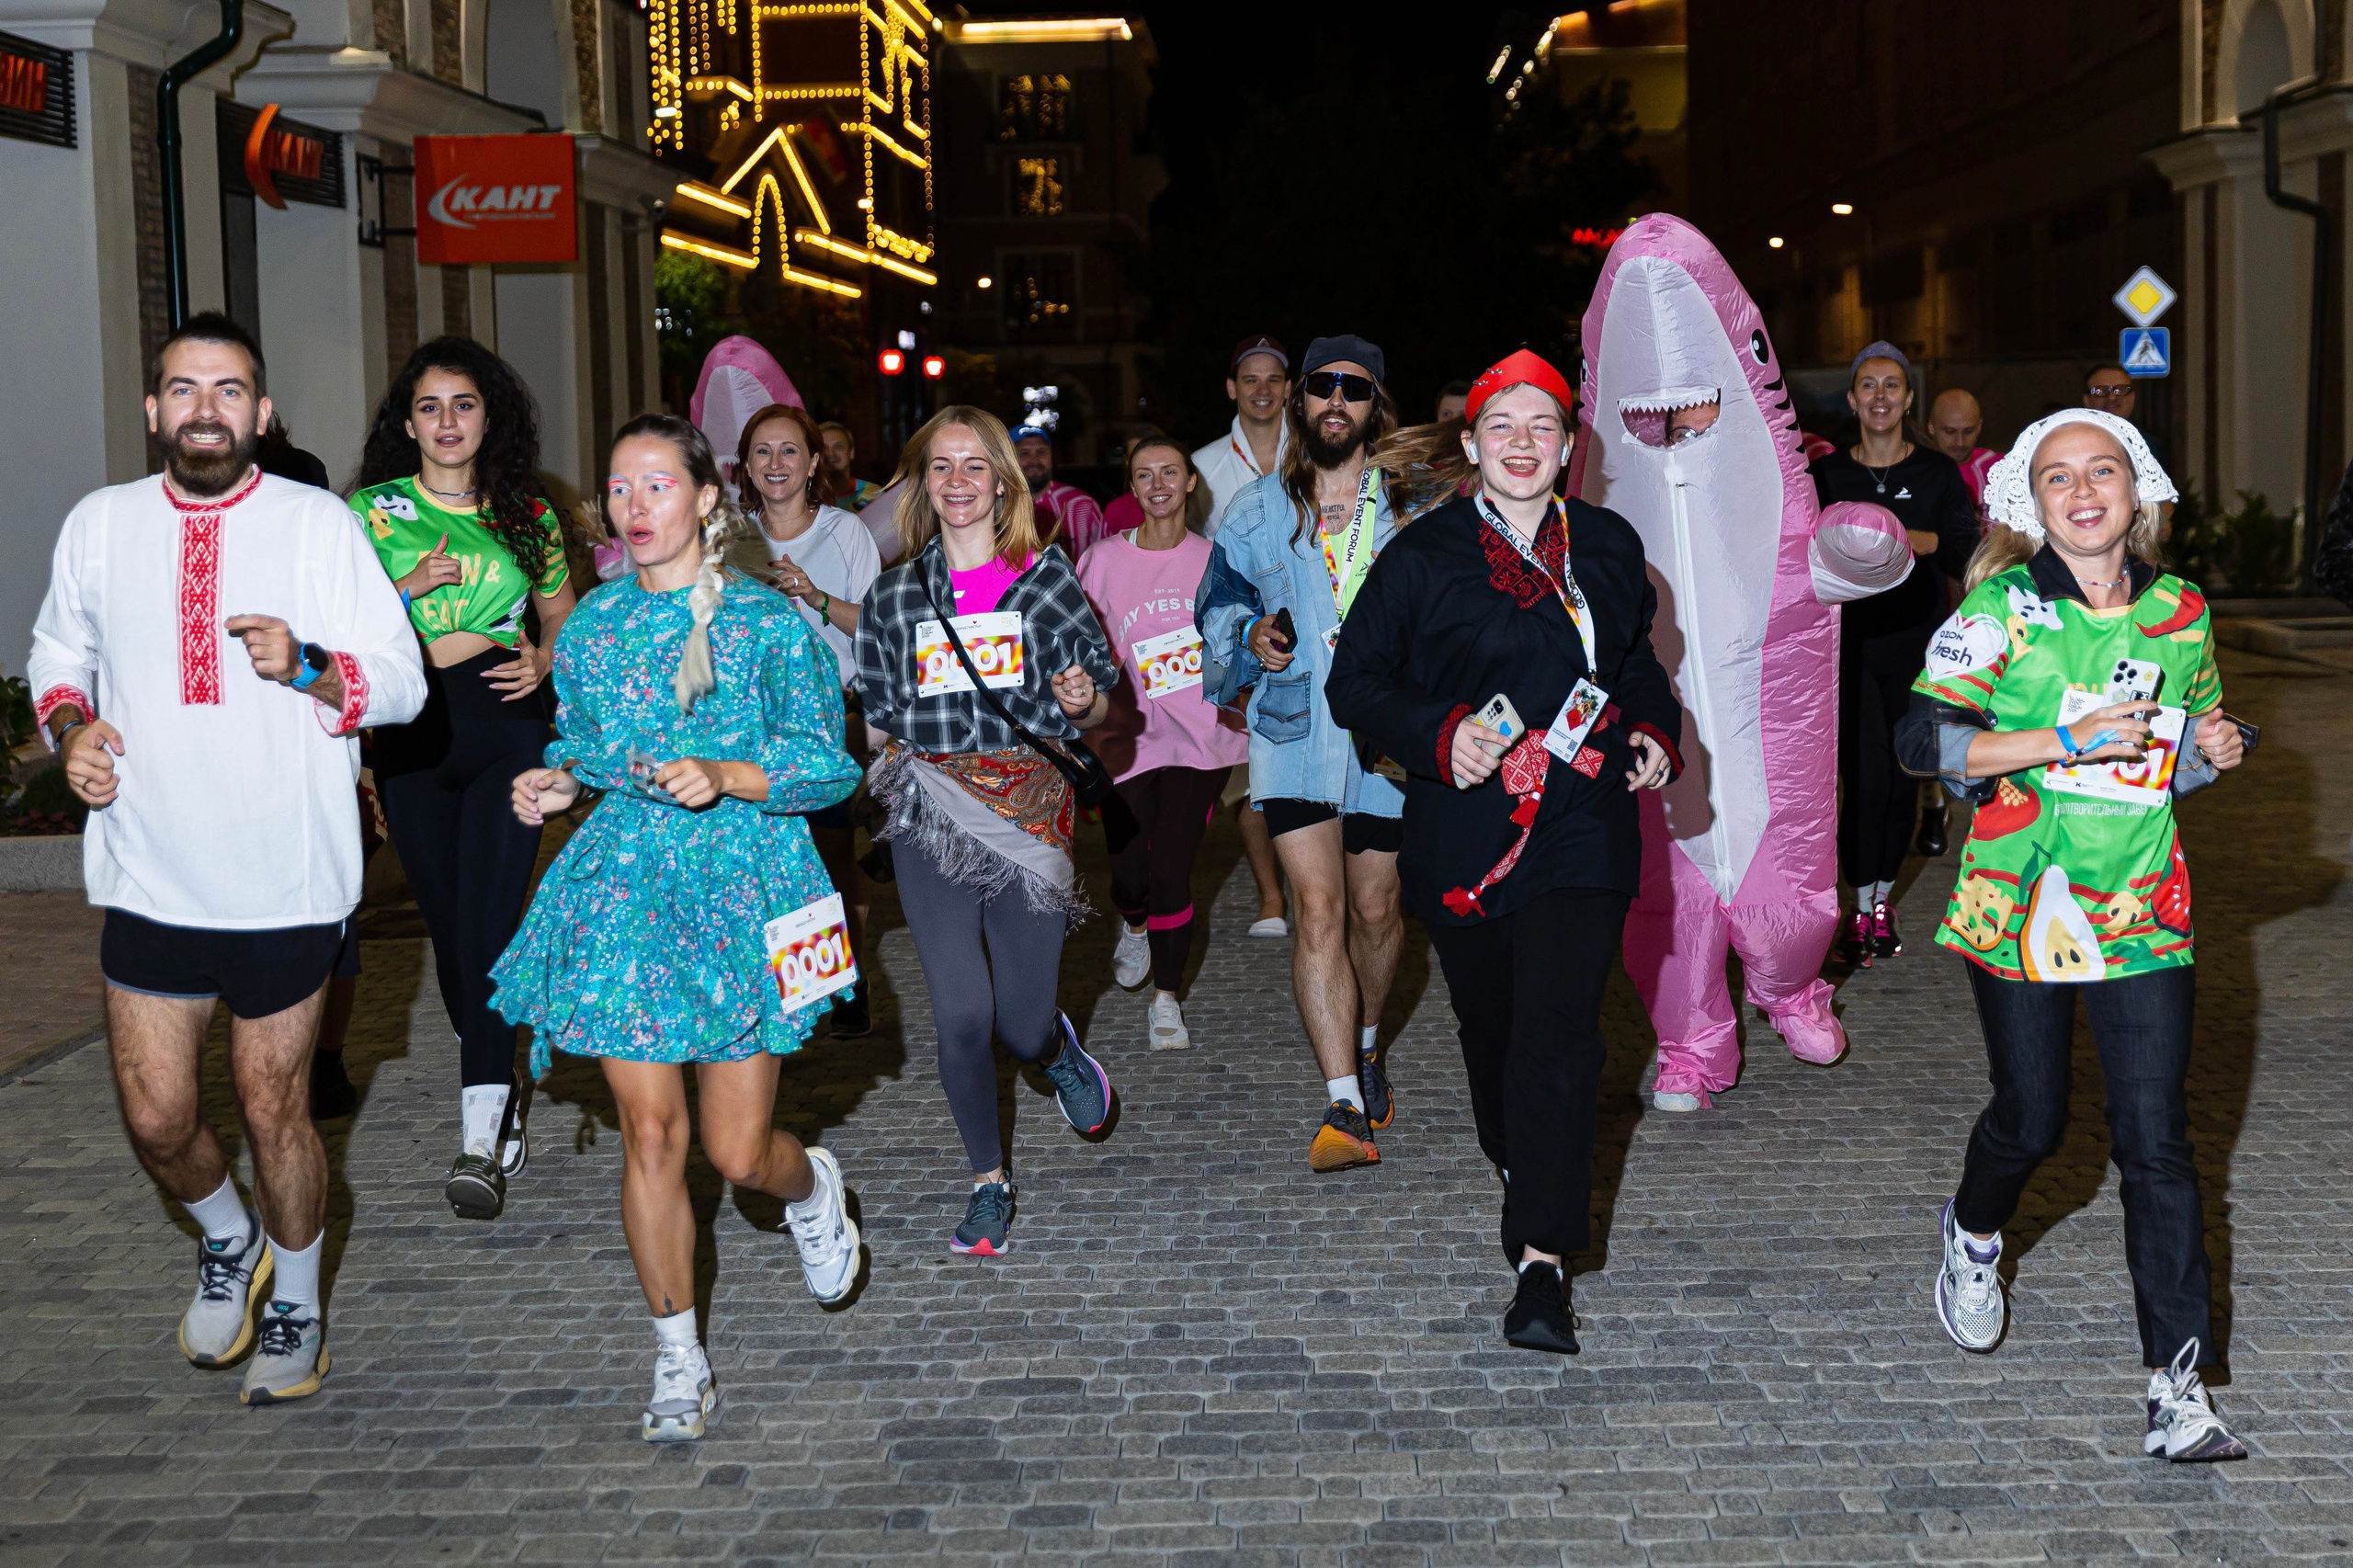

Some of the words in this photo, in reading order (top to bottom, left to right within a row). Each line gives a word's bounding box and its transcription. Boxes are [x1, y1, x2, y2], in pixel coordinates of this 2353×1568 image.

[450, 186, 562, 210] КАНТ
[1353, 497, 1366, 528] EVENT
[1346, 528, 1360, 562] FORUM
[1484, 512, 1518, 548] GLOBAL
[484, 560, 501, 583] &
[422, 598, 469, 632] EAT
[1119, 606, 1140, 643] SAY
[1143, 597, 1181, 615] YES
[926, 642, 1011, 678] 0001
[1147, 649, 1202, 683] 000
[781, 932, 846, 988] 0001
